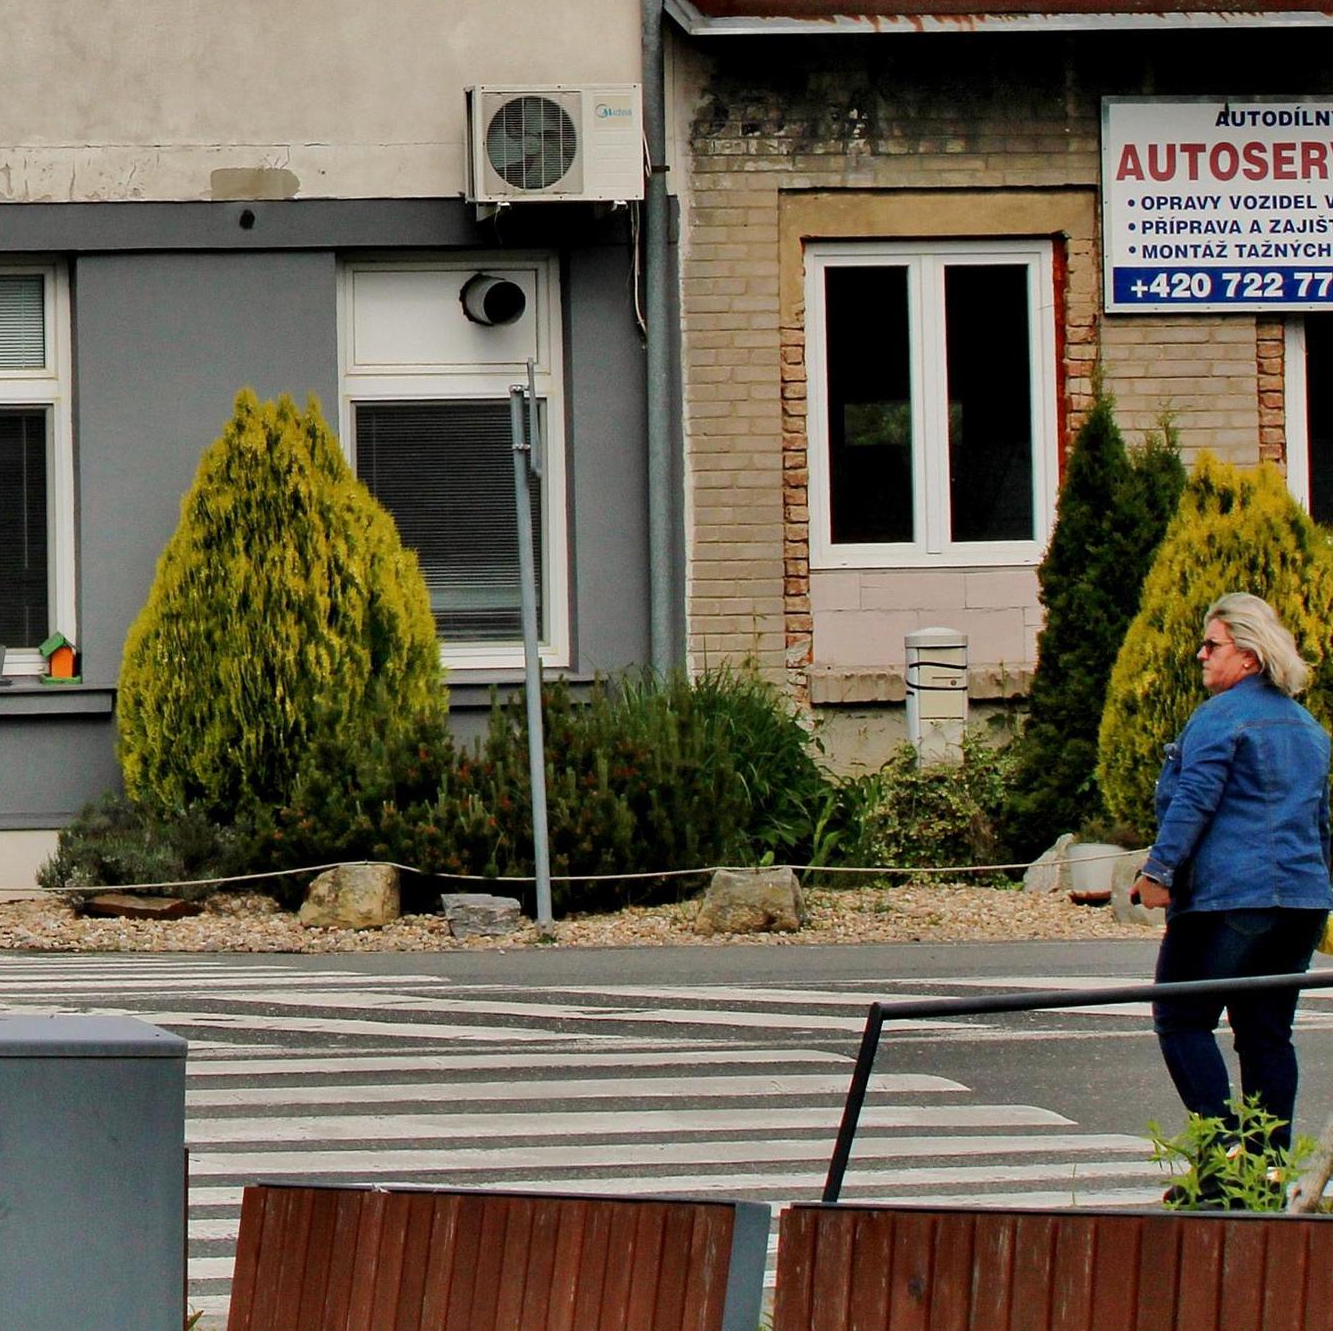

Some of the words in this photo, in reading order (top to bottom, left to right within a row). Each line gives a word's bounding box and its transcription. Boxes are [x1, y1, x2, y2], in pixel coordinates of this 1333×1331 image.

[1215, 105, 1333, 127] AUTODÍLN
[1115, 141, 1333, 182] AUTOSER
[1140, 195, 1222, 211] OPRAVY
[1229, 194, 1318, 210] VOZIDEL
[1141, 216, 1242, 235] PŘÍPRAVA
[1249, 219, 1262, 234] A
[1141, 240, 1228, 259] MONTÁŽ
[1235, 239, 1331, 258] TAŽNÝCH
[1130, 272, 1213, 298] +420
[1222, 271, 1284, 298] 722
[1293, 271, 1333, 298] 77
